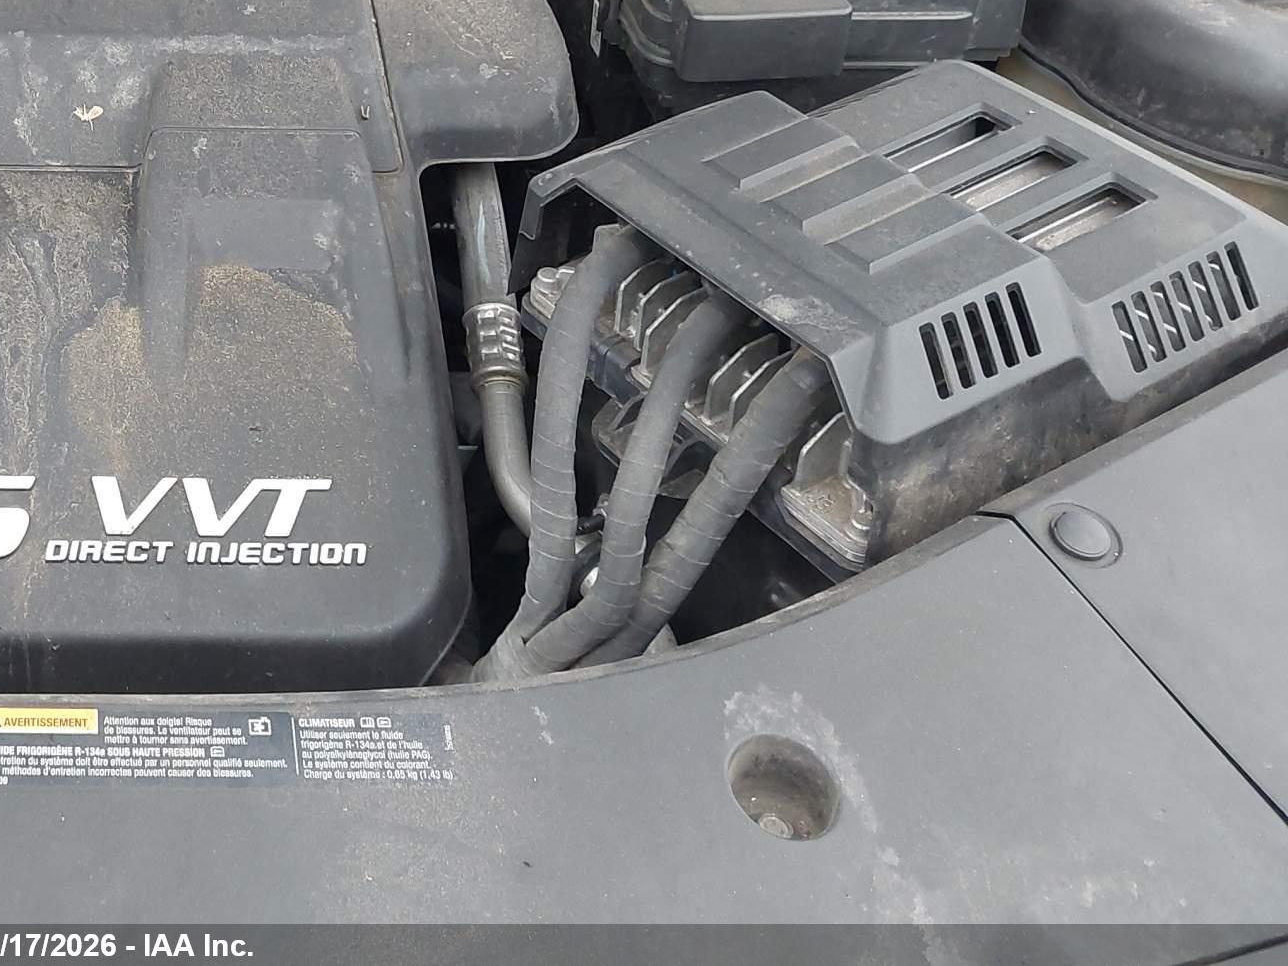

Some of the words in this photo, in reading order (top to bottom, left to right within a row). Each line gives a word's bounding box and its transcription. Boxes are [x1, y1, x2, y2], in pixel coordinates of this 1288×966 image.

[91, 475, 332, 537] VVT
[45, 541, 174, 563] DIRECT
[186, 542, 368, 565] INJECTION
[4, 717, 89, 727] AVERTISSEMENT
[103, 716, 139, 726] Attention
[140, 717, 155, 726] aux
[185, 717, 212, 728] Risque
[298, 718, 355, 728] CLIMATISEUR
[103, 725, 114, 735] de
[115, 726, 155, 735] blessures.
[157, 726, 168, 735] Le
[169, 726, 210, 735] ventilateur
[212, 726, 230, 737] peut
[232, 727, 242, 736] se
[299, 729, 327, 739] Utiliser
[329, 730, 370, 740] seulement
[372, 730, 379, 740] le
[380, 730, 404, 740] fluide
[104, 735, 130, 744] mettre
[139, 735, 168, 744] tourner
[169, 736, 189, 745] sans
[190, 736, 249, 746] avertissement.
[345, 740, 375, 749] R-134a
[376, 740, 385, 750] et
[386, 740, 397, 749] de
[16, 744, 73, 756] FRIGORIGÈNE
[74, 746, 106, 757] R-134a
[107, 746, 130, 757] SOUS
[132, 747, 161, 757] HAUTE
[162, 747, 206, 758] PRESSION
[301, 750, 312, 759] au
[387, 750, 410, 761] (huile
[27, 756, 38, 765] du
[40, 756, 74, 767] système
[75, 757, 91, 767] doit
[92, 757, 109, 767] être
[110, 757, 142, 767] effectué
[144, 759, 158, 768] par
[159, 759, 170, 767] un
[171, 758, 211, 769] personnel
[212, 758, 242, 769] qualifié
[243, 758, 288, 768] seulement.
[302, 759, 313, 769] Le
[349, 760, 383, 769] contient
[383, 760, 395, 769] du
[2, 766, 41, 776] méthodes
[87, 767, 132, 777] incorrectes
[133, 768, 166, 778] peuvent
[167, 769, 195, 777] causer
[196, 768, 212, 777] des
[213, 768, 254, 778] blessures.
[303, 769, 332, 780] Charge
[334, 769, 345, 779] du
[407, 770, 418, 781] kg
[442, 769, 453, 780] lb)
